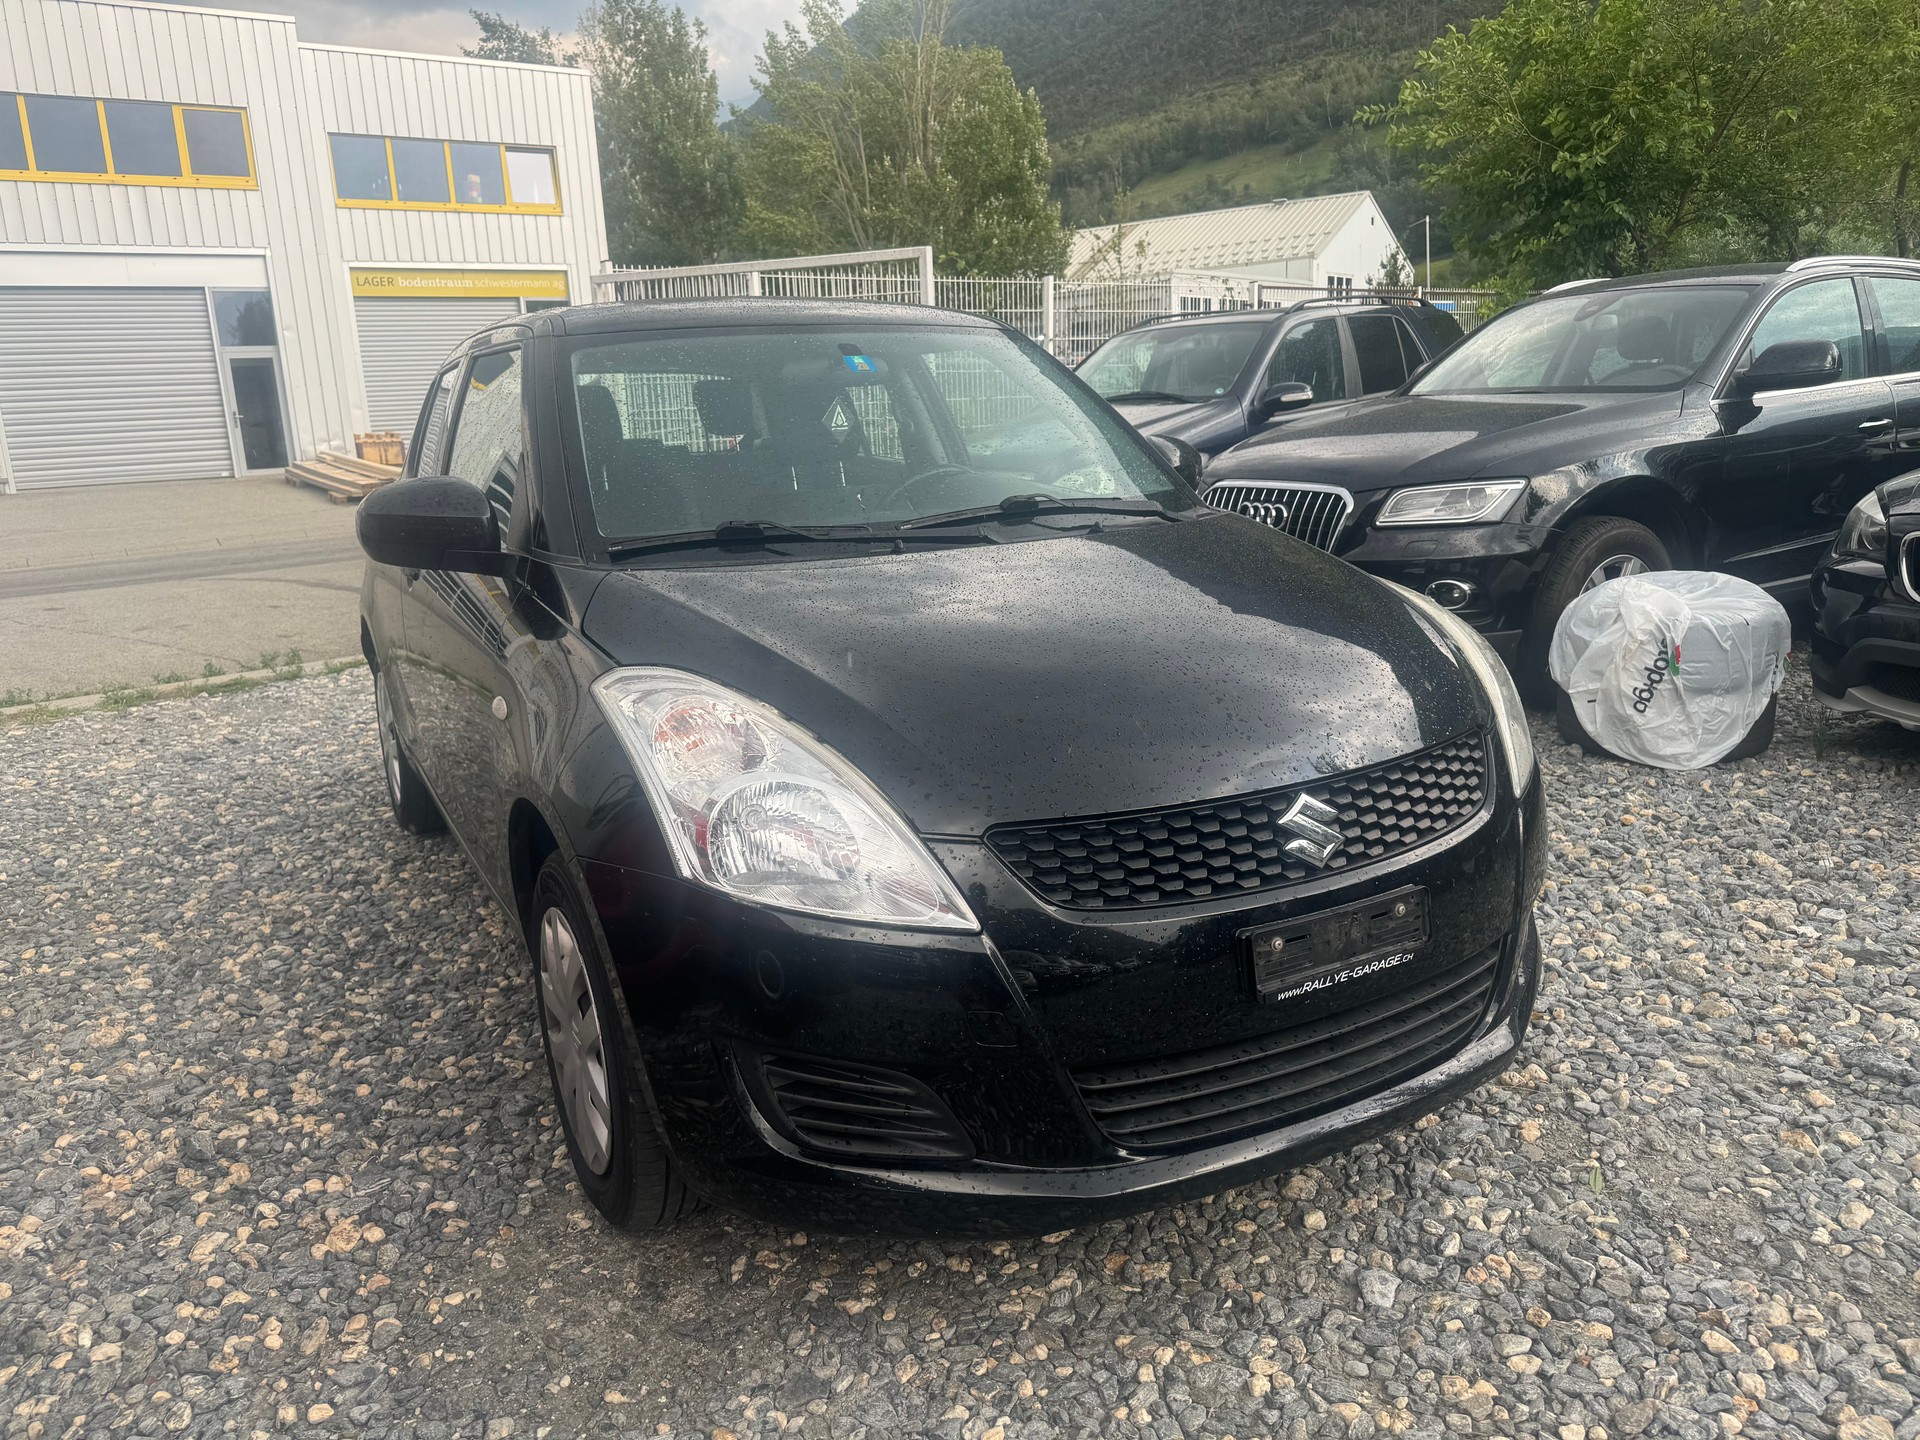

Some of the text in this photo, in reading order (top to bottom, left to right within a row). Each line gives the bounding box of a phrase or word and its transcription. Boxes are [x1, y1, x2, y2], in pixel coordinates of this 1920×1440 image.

[356, 276, 565, 291] LAGER bodentraum schwestermann ag
